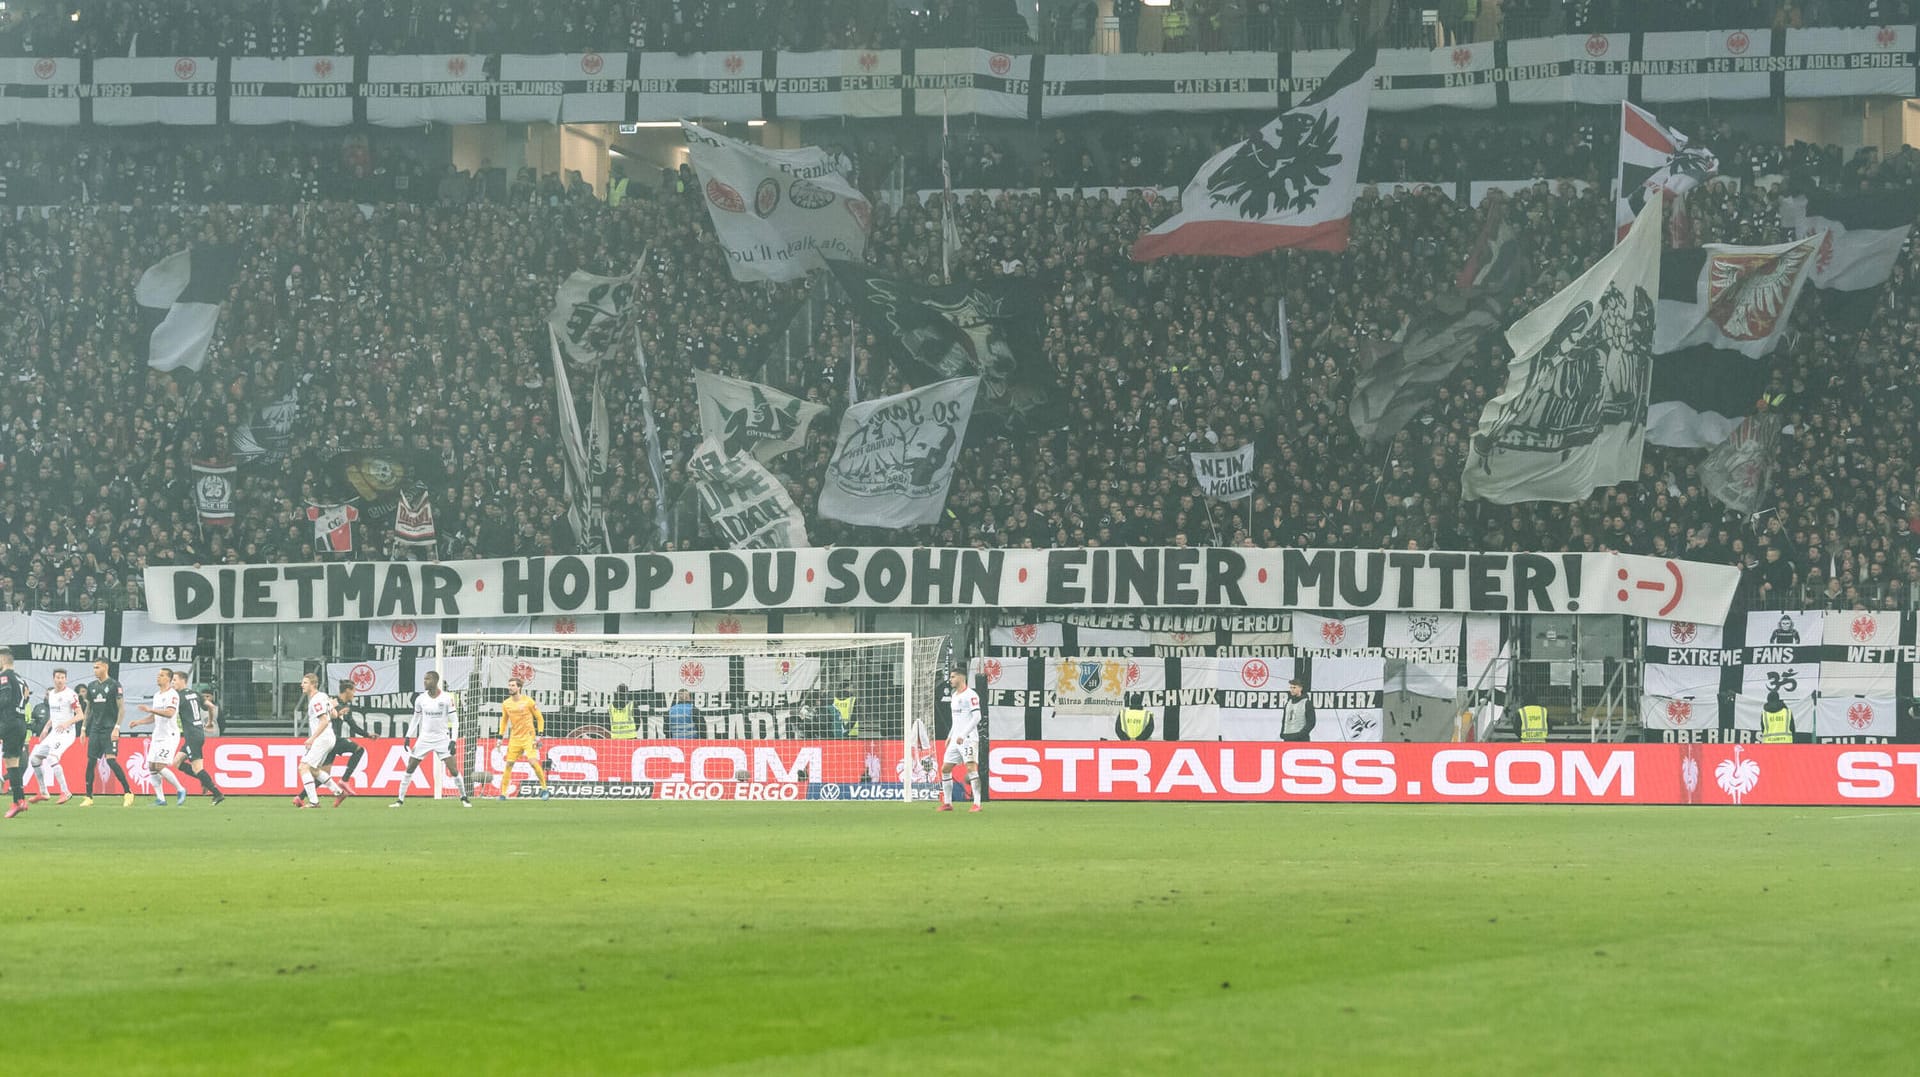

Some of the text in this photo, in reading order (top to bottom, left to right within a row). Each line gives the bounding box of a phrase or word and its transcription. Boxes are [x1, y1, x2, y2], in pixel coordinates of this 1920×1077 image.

[1574, 60, 1596, 74] EFC
[1734, 56, 1800, 72] PREUSSEN
[586, 79, 608, 93] EFC
[841, 76, 867, 90] EFC
[872, 76, 895, 89] DIE
[1005, 79, 1029, 95] EFC
[1174, 78, 1249, 93] CARSTEN
[1444, 71, 1473, 87] BAD
[99, 84, 132, 97] 1999
[187, 83, 215, 96] EFC
[297, 84, 346, 97] ANTON
[1200, 454, 1245, 478] NEIN
[1210, 473, 1257, 496] MÖLLER
[173, 562, 463, 620] DIETMAR
[502, 554, 675, 615] HOPP
[709, 550, 796, 612] DU
[824, 547, 1005, 606] SOHN
[1046, 547, 1247, 607] EINER
[1282, 549, 1583, 613] MUTTER!
[30, 644, 122, 663] WINNETOU
[375, 645, 402, 661] THE
[1668, 647, 1794, 666] EXTREME FANS
[747, 690, 802, 707] CREW
[1013, 690, 1051, 707] SEK
[1129, 689, 1217, 707] ACHWUX
[1308, 691, 1376, 709] UNTERZ
[158, 748, 170, 759] 22
[988, 747, 1635, 797] STRAUSS.COM
[520, 785, 651, 797] STRAUSS.COM
[659, 782, 724, 801] ERGO
[733, 782, 798, 801] ERGO
